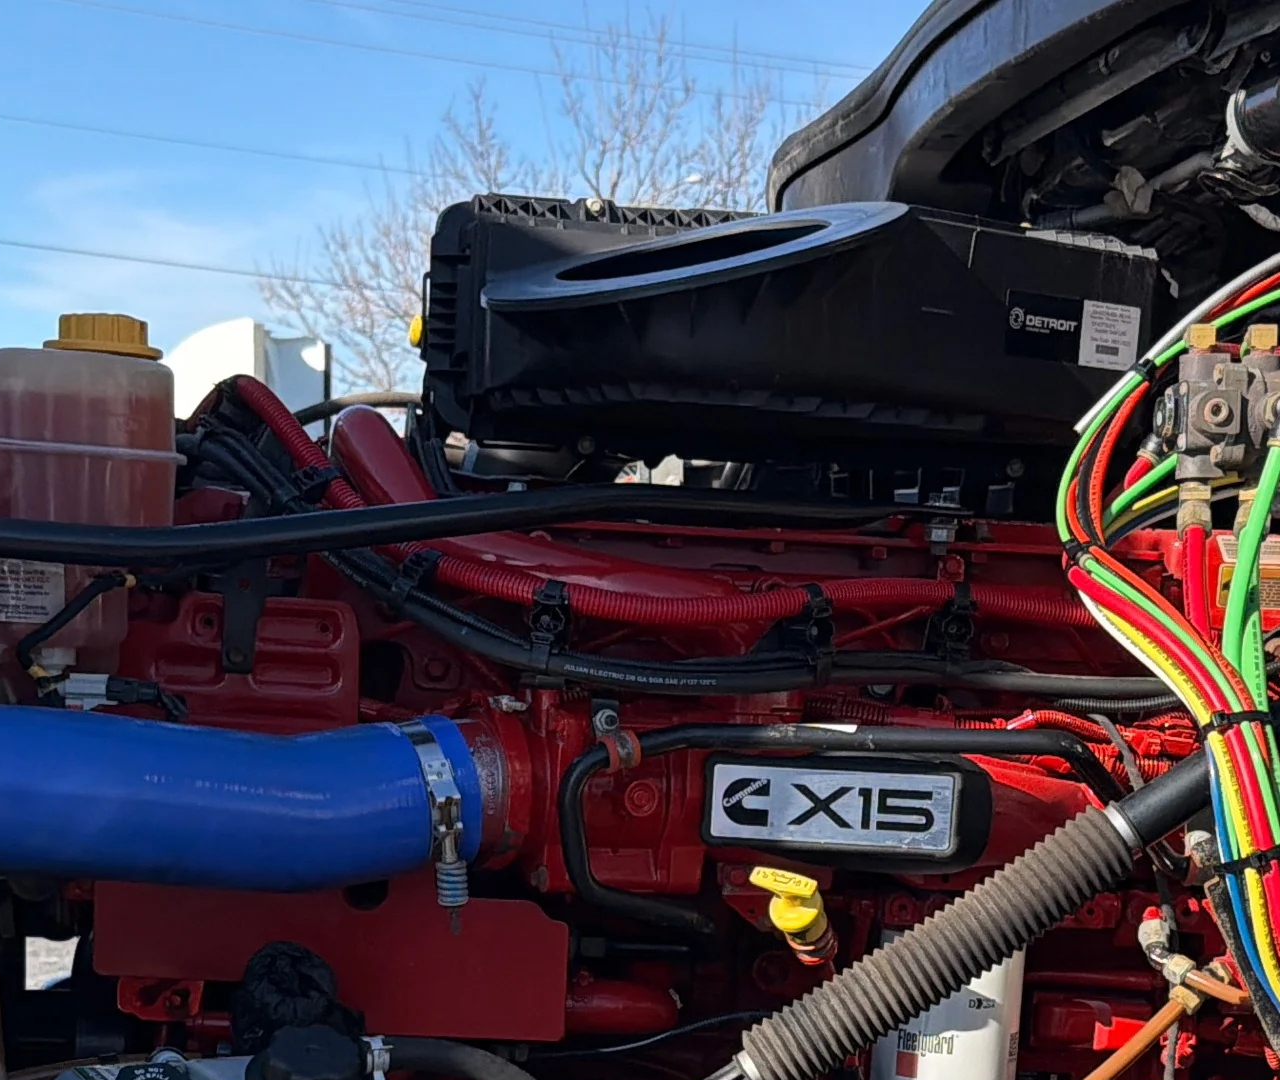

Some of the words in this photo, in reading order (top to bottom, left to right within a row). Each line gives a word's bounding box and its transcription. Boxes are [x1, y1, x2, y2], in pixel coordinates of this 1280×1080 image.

[1026, 314, 1078, 332] DETROIT
[564, 664, 588, 674] JULIAN
[589, 668, 624, 681] ELECTRIC
[723, 779, 768, 807] Cummins
[787, 783, 934, 832] X15
[897, 1029, 954, 1057] Fleetguard
